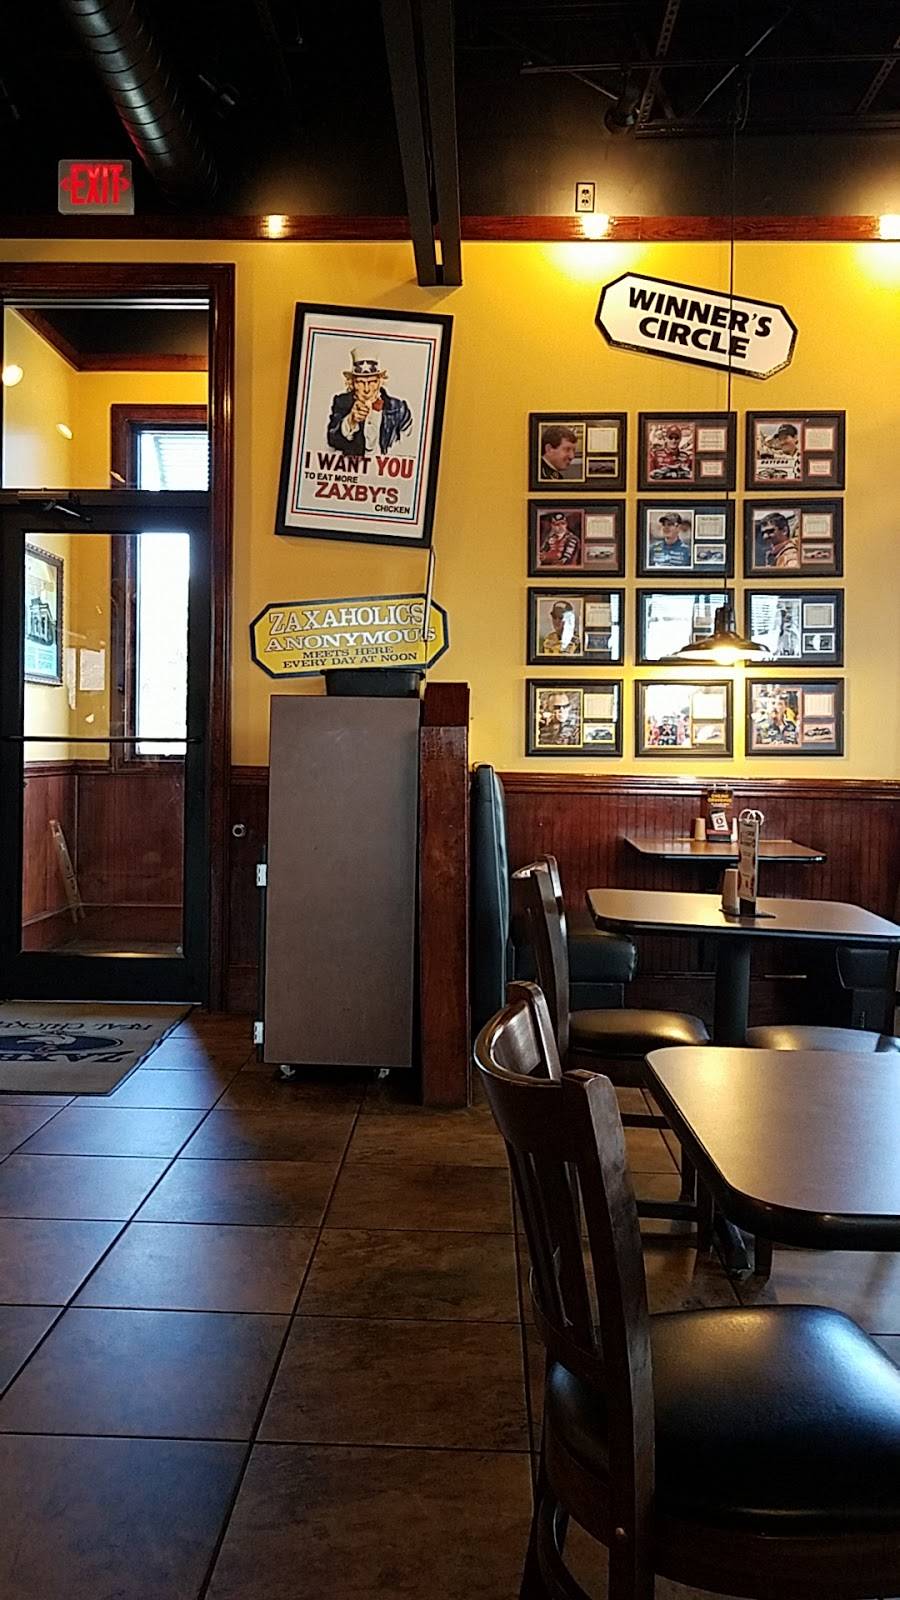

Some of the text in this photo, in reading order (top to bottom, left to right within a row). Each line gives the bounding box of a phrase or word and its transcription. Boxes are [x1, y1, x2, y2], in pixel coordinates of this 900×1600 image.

[71, 164, 123, 205] EXIT
[628, 287, 773, 337] WINNER'S
[639, 316, 750, 359] CIRCLE
[304, 451, 414, 479] I WANT YOU
[304, 471, 358, 483] TO EAT MORE
[315, 482, 399, 504] ZAXBY'S
[375, 504, 411, 514] CHICKEN
[269, 602, 426, 636] ZAXAHOLICS
[265, 627, 436, 653] ANONYMOUS
[303, 646, 394, 659] MEETS HERE
[283, 652, 417, 669] EVERY DAY AT NOON
